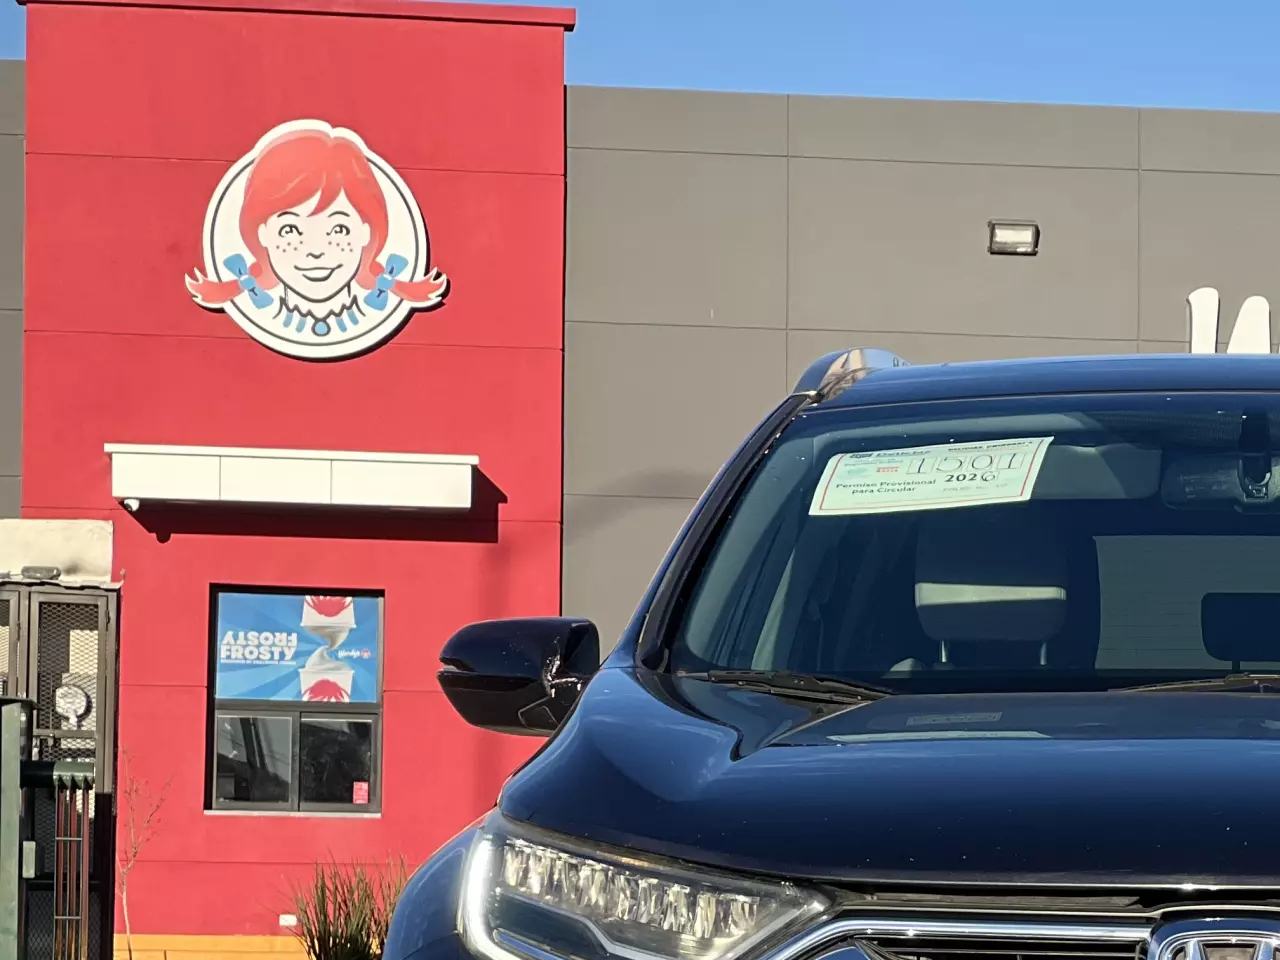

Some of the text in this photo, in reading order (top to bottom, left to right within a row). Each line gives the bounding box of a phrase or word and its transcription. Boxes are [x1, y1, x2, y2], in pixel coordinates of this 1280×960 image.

[880, 479, 936, 487] Provisional
[222, 631, 297, 646] FROSTY
[220, 645, 297, 660] FROSTY
